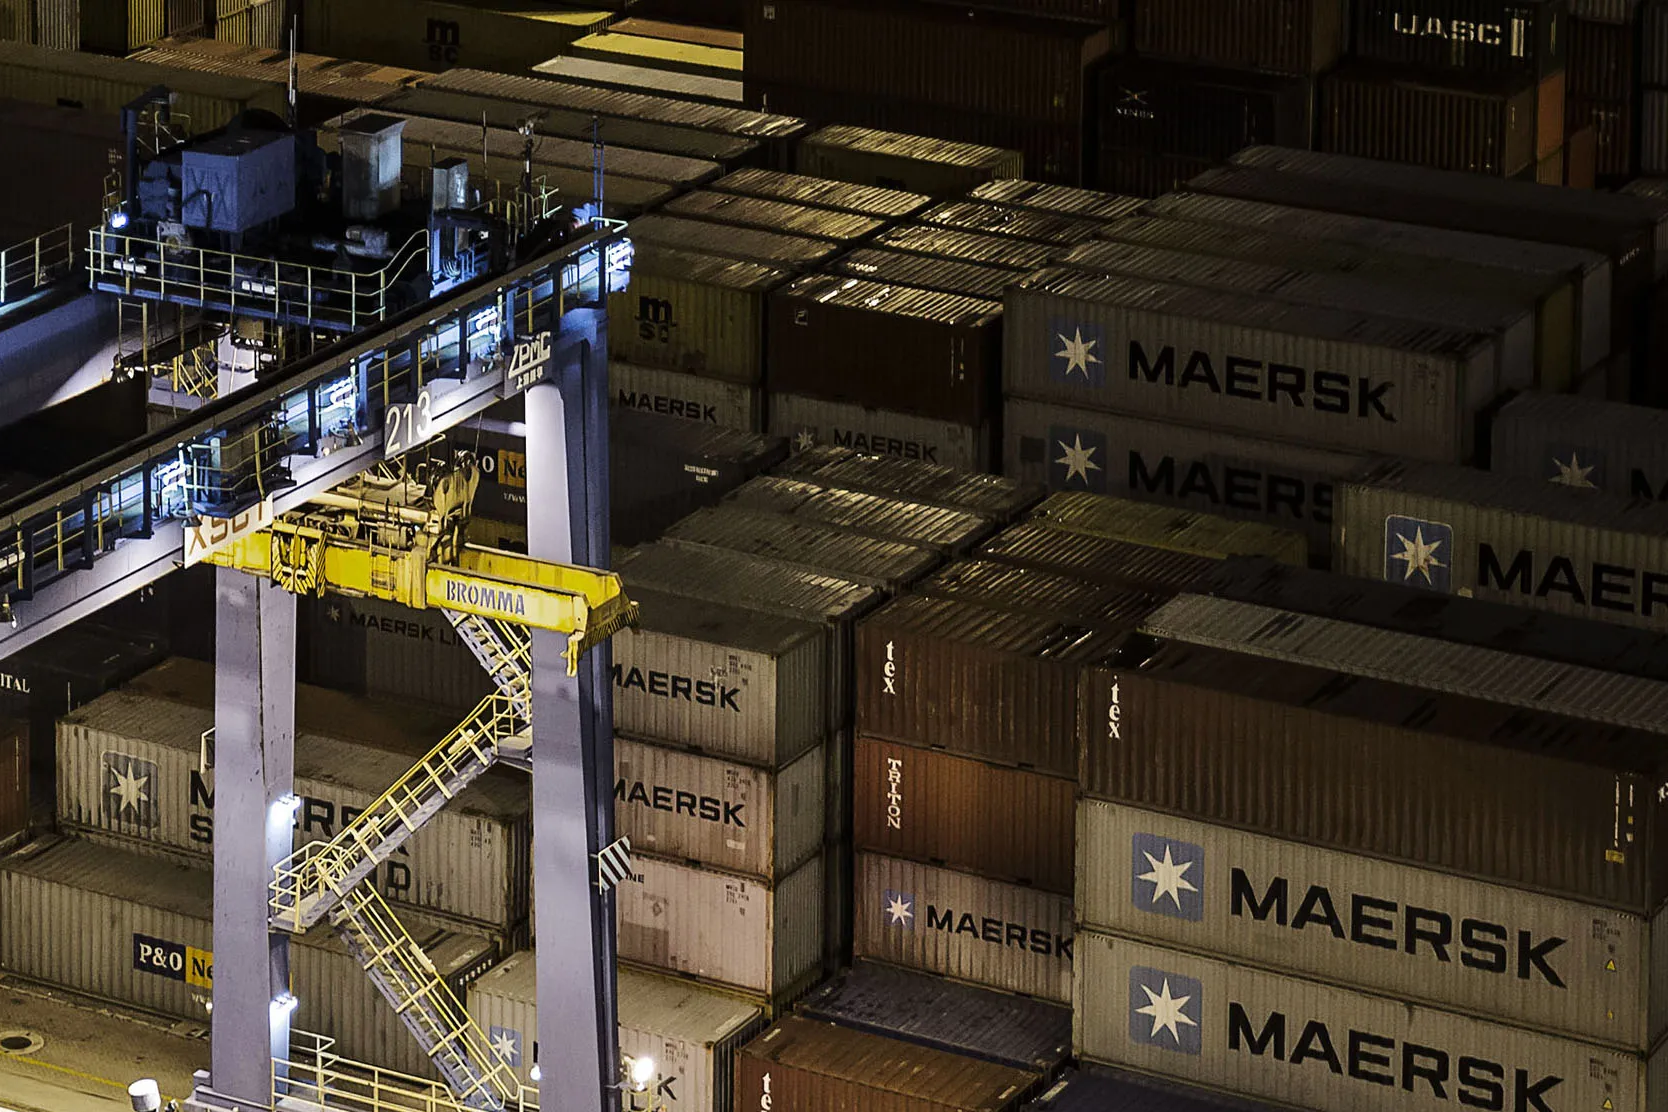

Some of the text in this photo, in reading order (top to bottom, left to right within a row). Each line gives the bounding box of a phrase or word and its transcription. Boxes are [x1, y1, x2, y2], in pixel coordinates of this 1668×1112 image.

[618, 388, 718, 425] MAERSK
[1128, 339, 1399, 424] MAERSK
[385, 391, 433, 453] 213
[833, 428, 939, 463] MAERSK
[1128, 450, 1333, 525] MAERS
[446, 579, 526, 616] BROMMA
[349, 611, 433, 643] MAERSK
[883, 640, 897, 697] tex
[1107, 673, 1122, 741] tex
[887, 757, 903, 830] TRITON
[926, 904, 1074, 962] MAERSK
[1229, 866, 1568, 989] MAERSK
[139, 942, 183, 972] P&O
